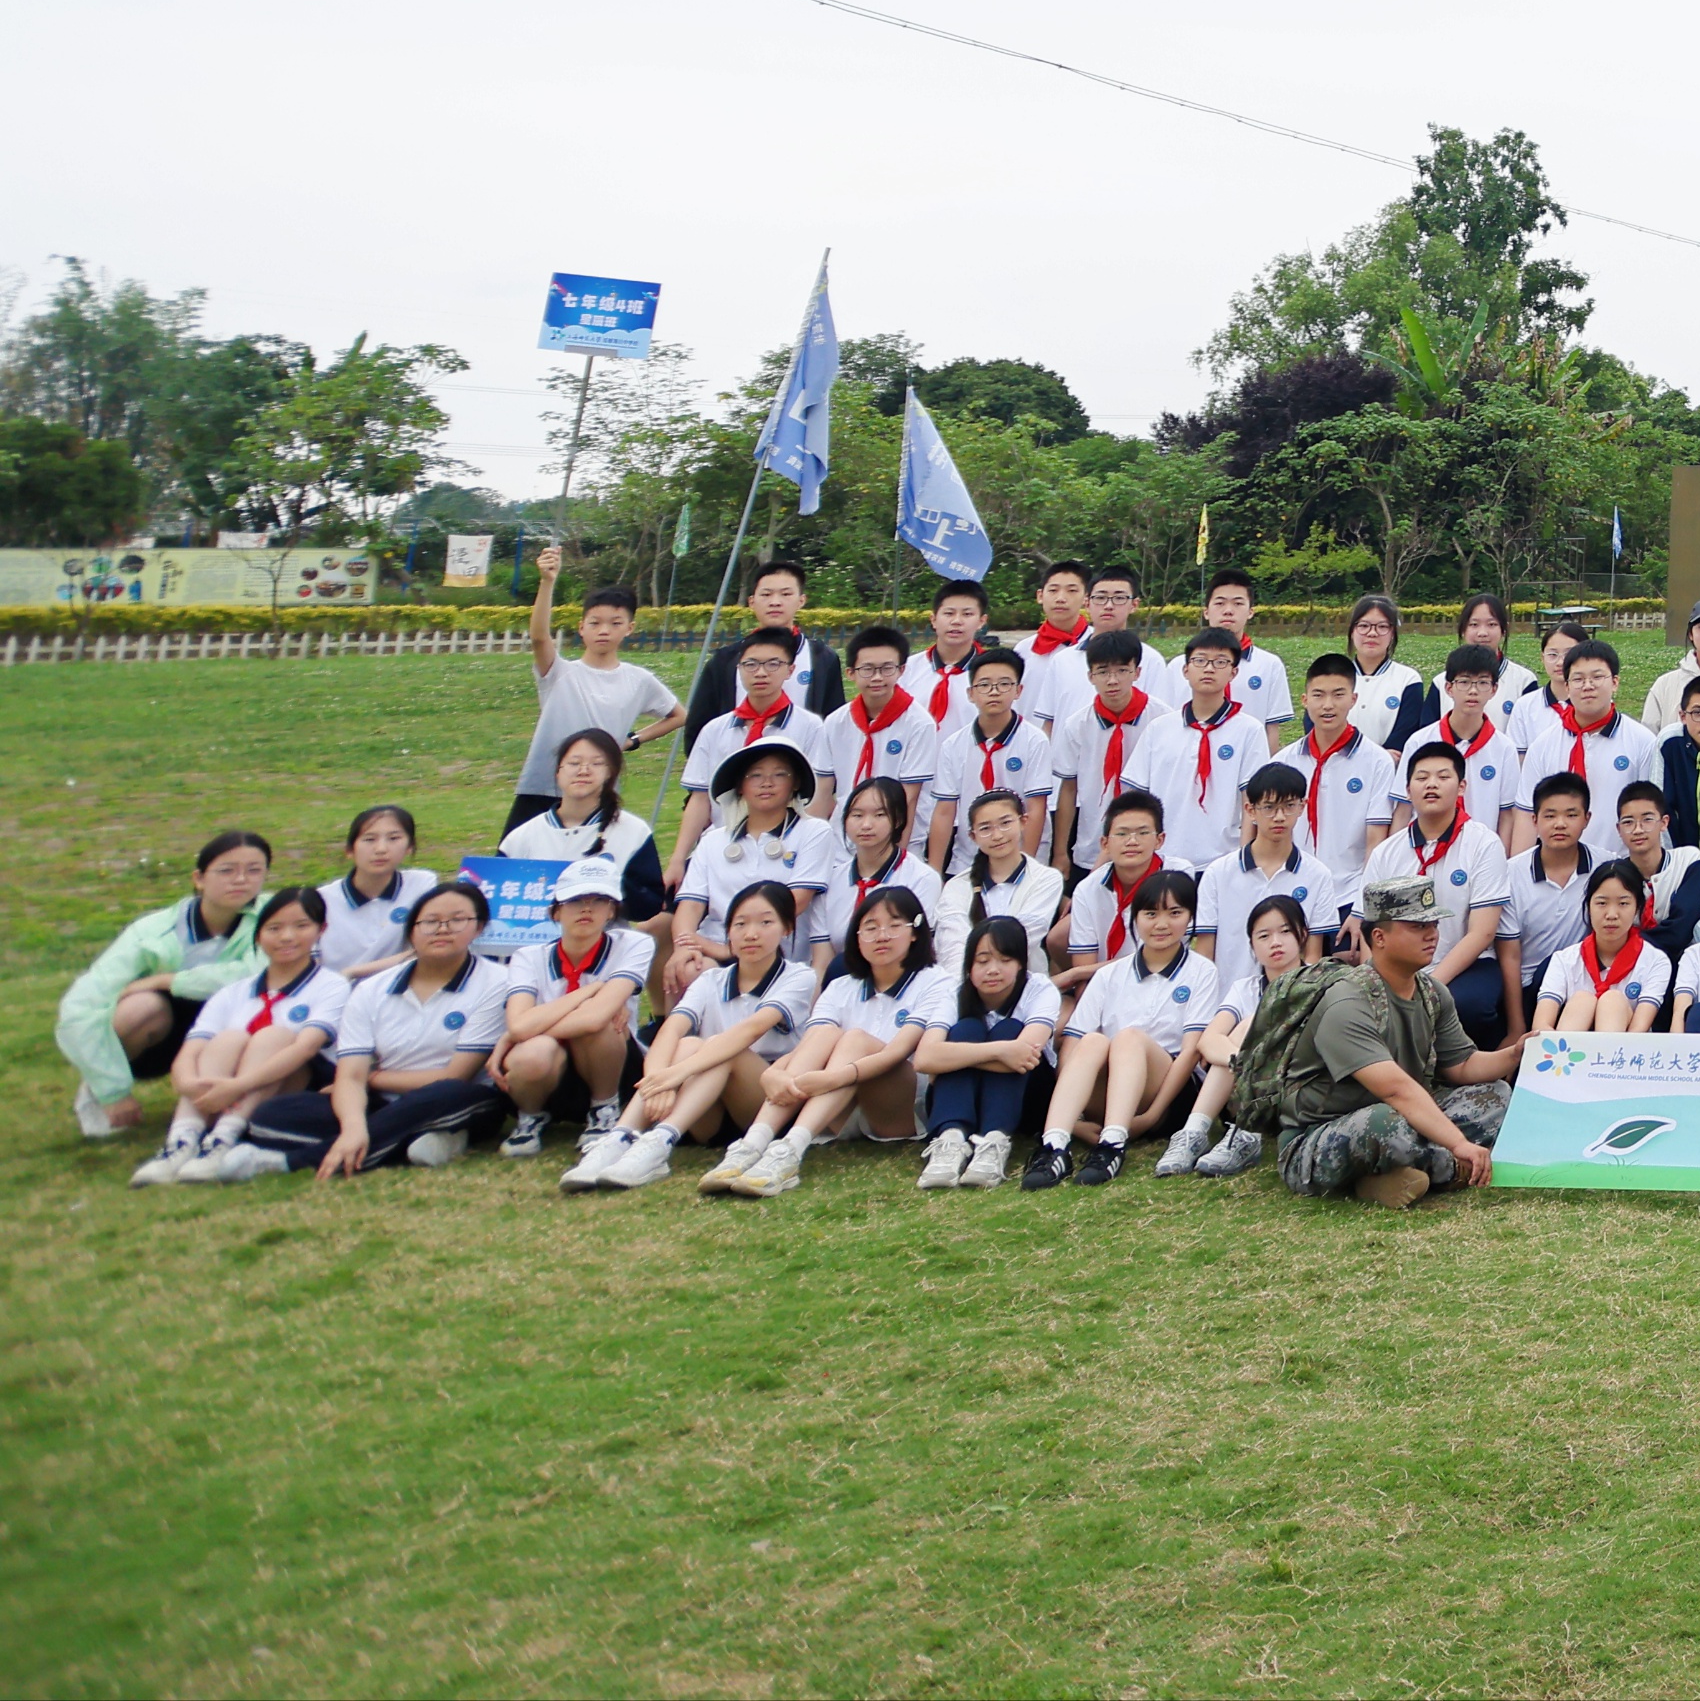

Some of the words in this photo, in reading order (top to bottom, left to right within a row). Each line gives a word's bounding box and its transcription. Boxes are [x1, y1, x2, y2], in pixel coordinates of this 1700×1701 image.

[562, 292, 645, 315] 七年级4班
[479, 880, 557, 901] 七年级2
[1588, 1072, 1616, 1080] CHENGDU
